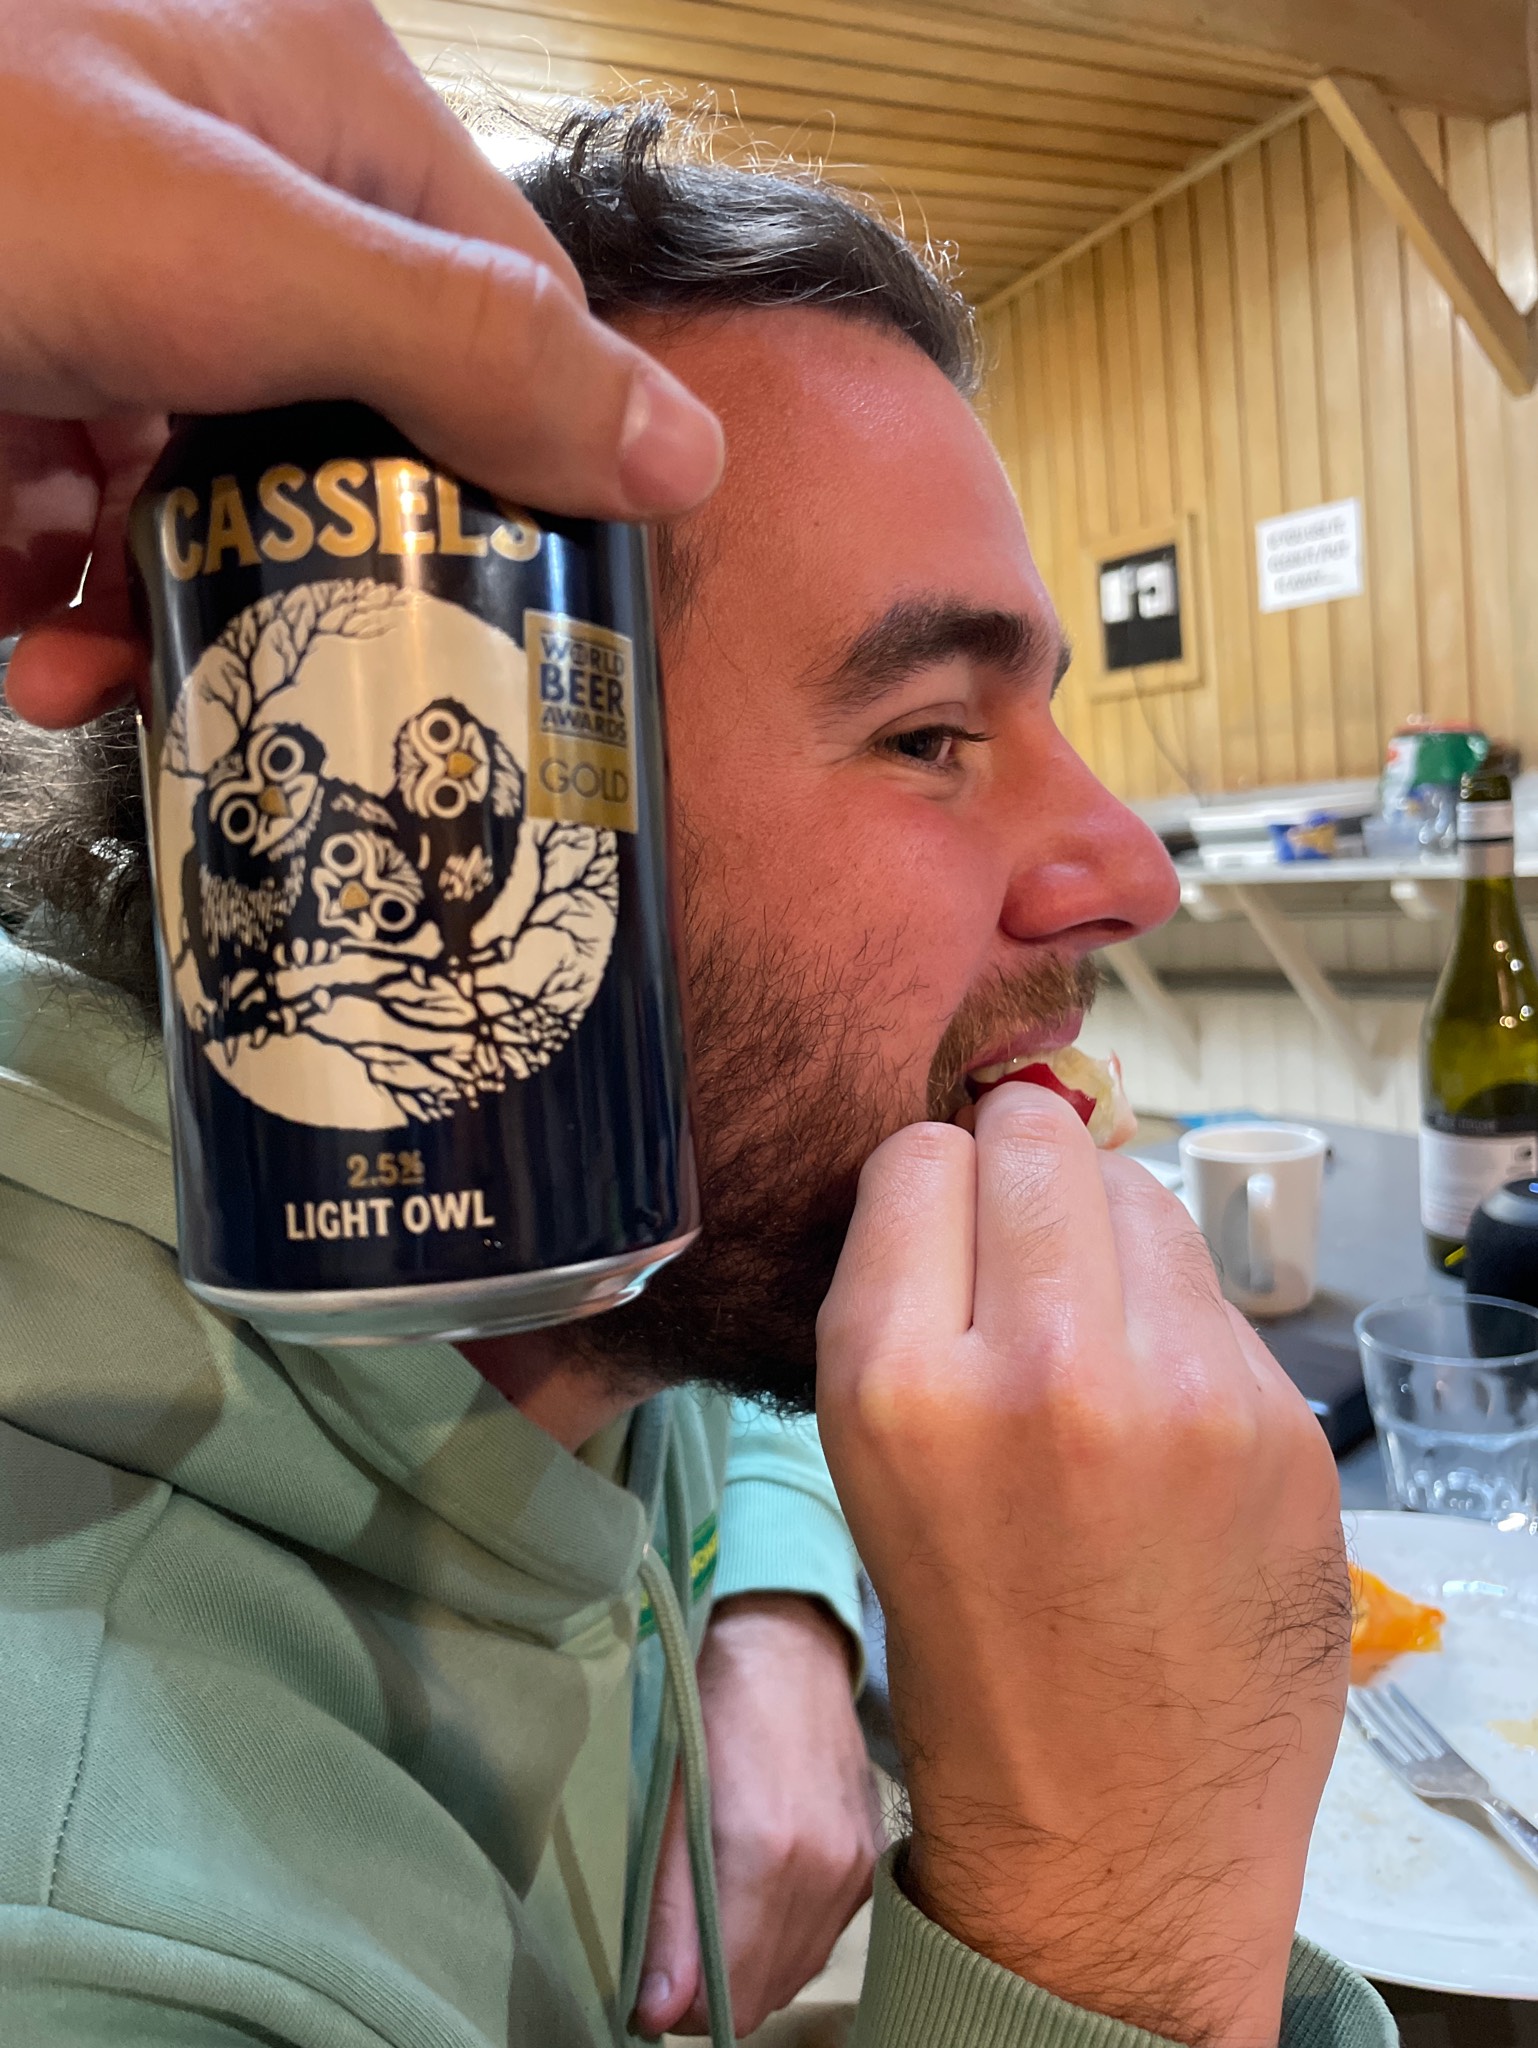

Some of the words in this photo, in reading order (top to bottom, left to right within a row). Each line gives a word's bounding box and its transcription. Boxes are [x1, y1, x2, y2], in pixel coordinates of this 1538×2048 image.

[540, 635, 625, 678] WORLD
[540, 662, 625, 718] BEER
[541, 704, 627, 741] AWARDS
[539, 757, 629, 804] GOLD
[346, 1150, 426, 1189] 2.5%
[284, 1197, 394, 1241] LIGHT
[402, 1188, 496, 1235] OWL
